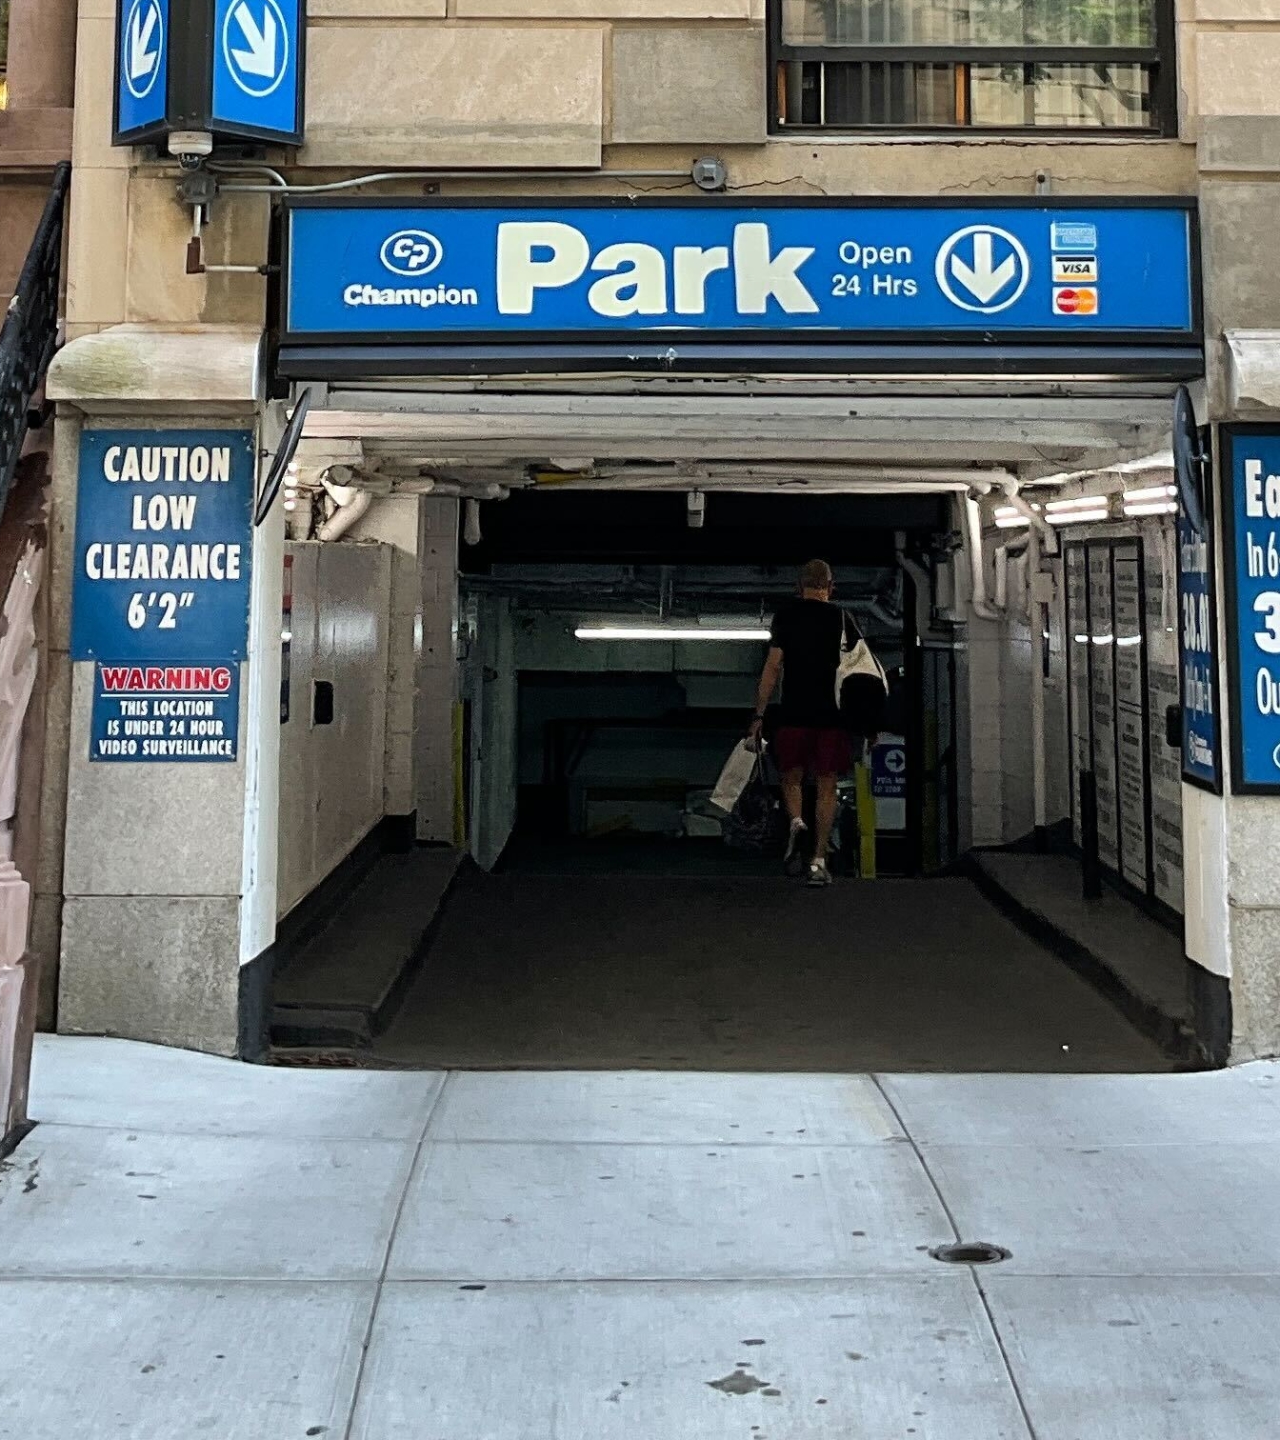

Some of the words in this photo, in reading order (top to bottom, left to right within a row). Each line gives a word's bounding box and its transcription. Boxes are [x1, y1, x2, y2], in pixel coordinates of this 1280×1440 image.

[839, 241, 912, 269] Open
[496, 221, 820, 317] Park
[1062, 263, 1091, 274] VISA
[343, 283, 478, 308] Champion
[831, 273, 862, 297] 24
[873, 273, 918, 297] Hrs
[103, 445, 230, 483] CAUTION
[132, 494, 197, 531] LOW
[86, 543, 241, 580] CLEARANCE
[1247, 531, 1264, 577] In
[127, 592, 195, 629] 6'2"
[101, 667, 231, 691] WARNING
[120, 700, 148, 716] THIS
[153, 700, 214, 716] LOCATION
[107, 720, 119, 736] IS
[124, 720, 164, 736] UNDER
[169, 720, 185, 736] 24
[190, 720, 224, 736] HOUR
[99, 739, 138, 755] VIDEO
[142, 739, 232, 755] SURVEILLANCE
